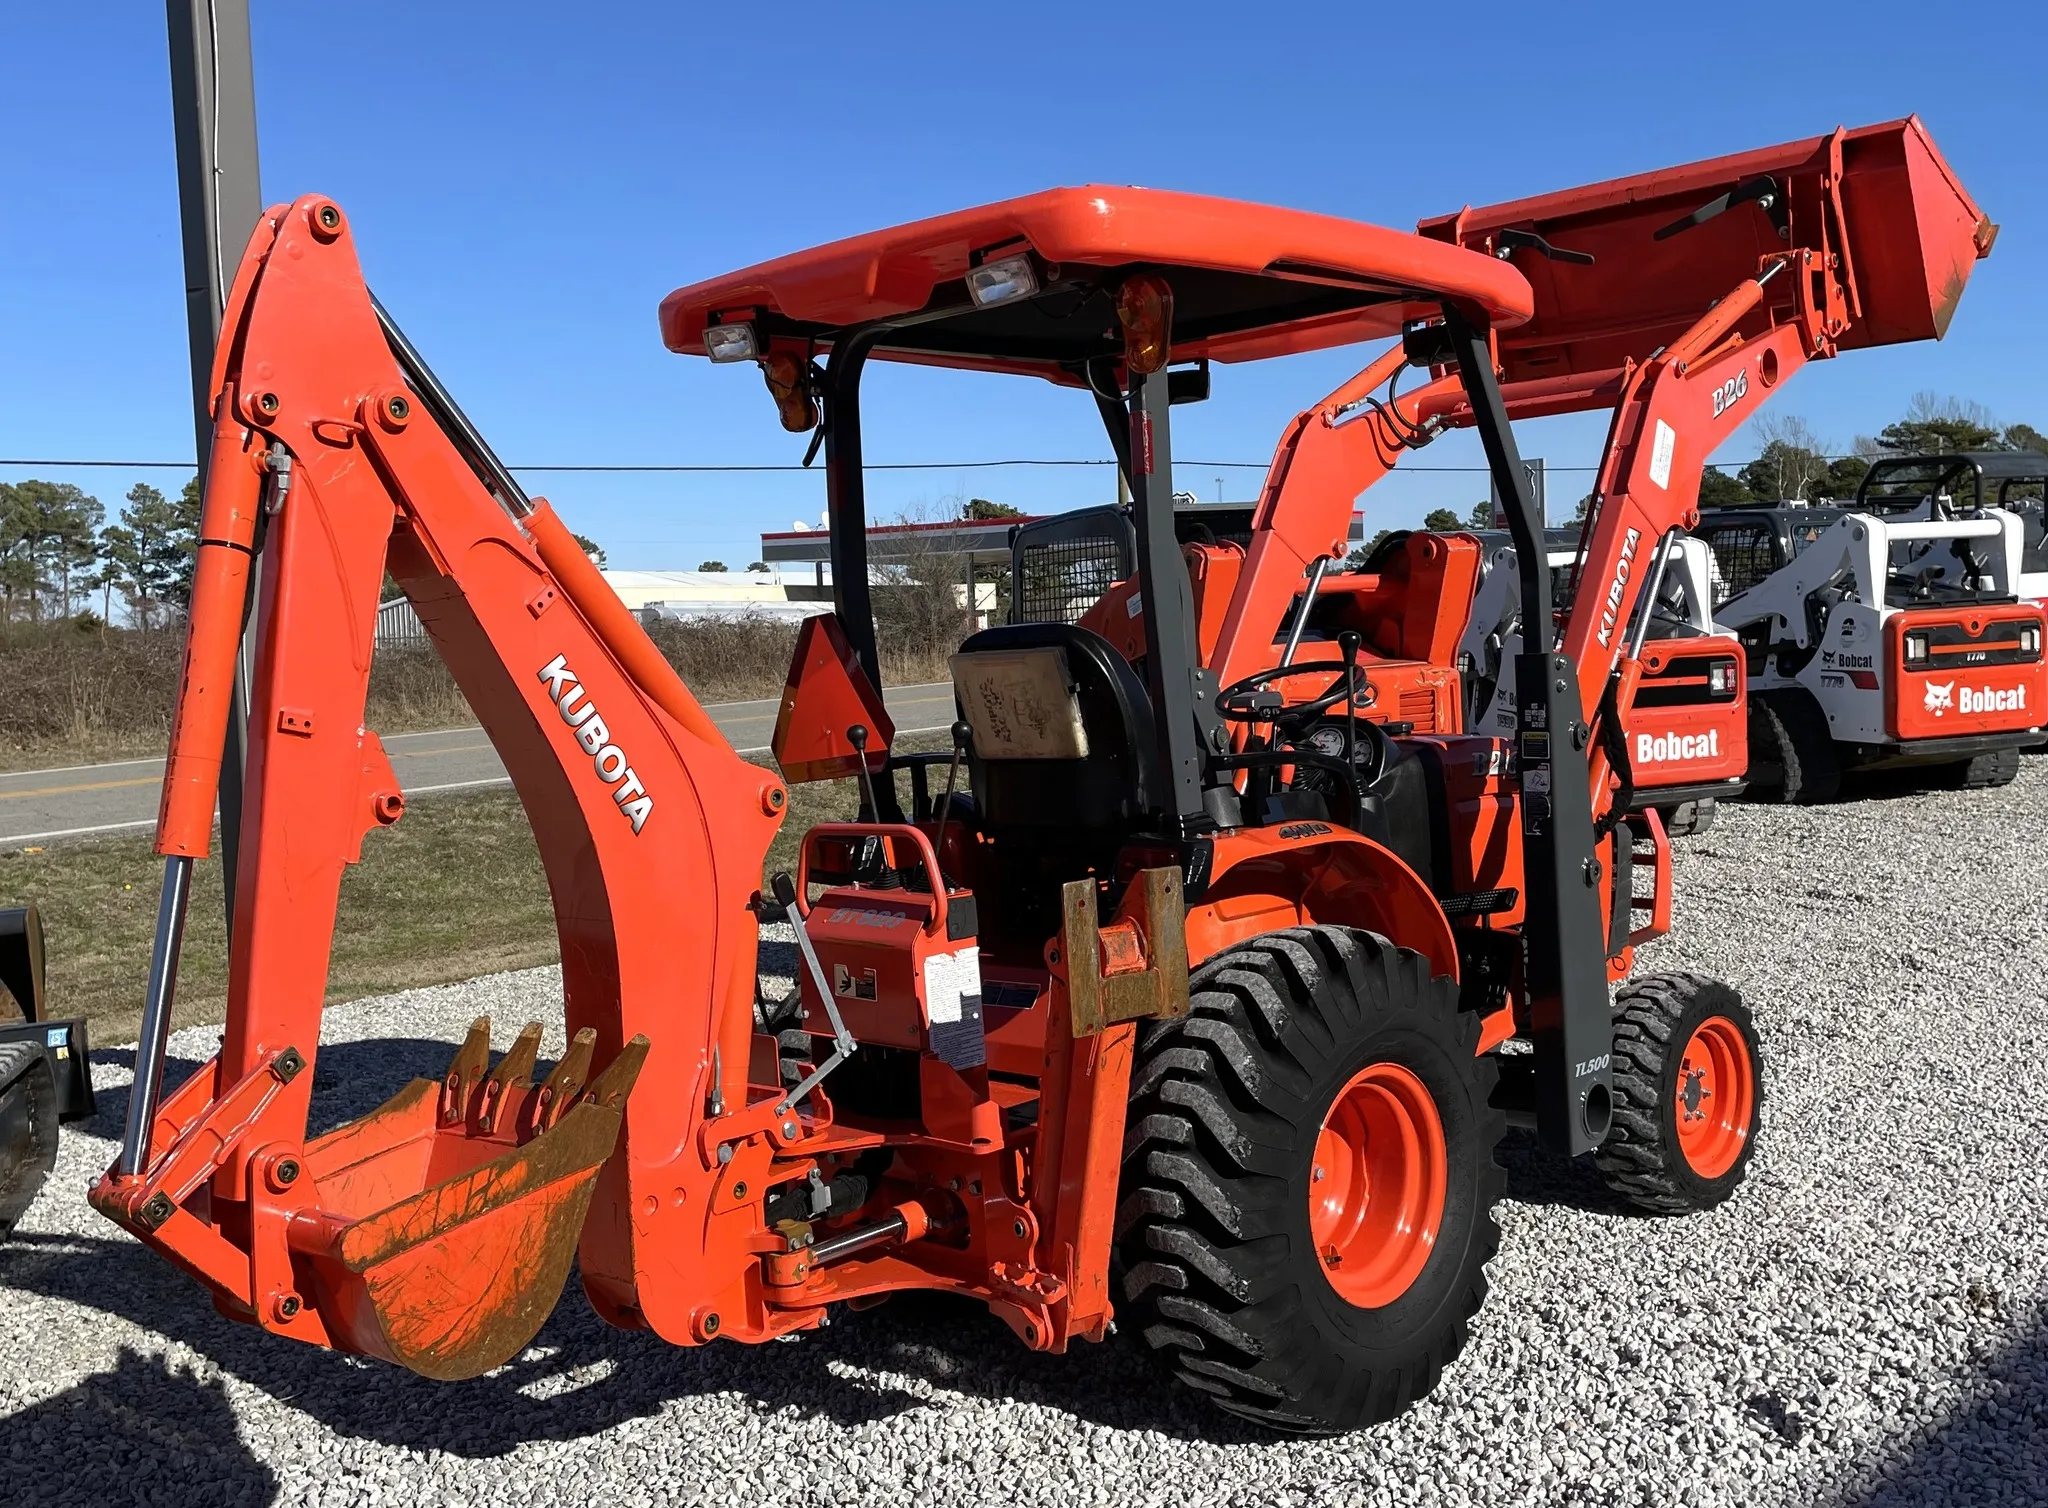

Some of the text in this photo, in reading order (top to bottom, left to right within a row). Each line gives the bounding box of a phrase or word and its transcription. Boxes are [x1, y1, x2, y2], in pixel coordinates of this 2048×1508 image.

[1711, 368, 1748, 419] B26
[1597, 526, 1642, 650] KUBOTA
[1838, 653, 1873, 668] Bobcat
[1966, 652, 1986, 661] T770
[1820, 675, 1845, 689] T770
[1960, 684, 2026, 714] Bobcat
[537, 652, 655, 837] KUBOTA
[1637, 729, 1718, 763] Bobcat
[1279, 823, 1333, 840] 4WD
[1575, 1053, 1610, 1078] TL500
